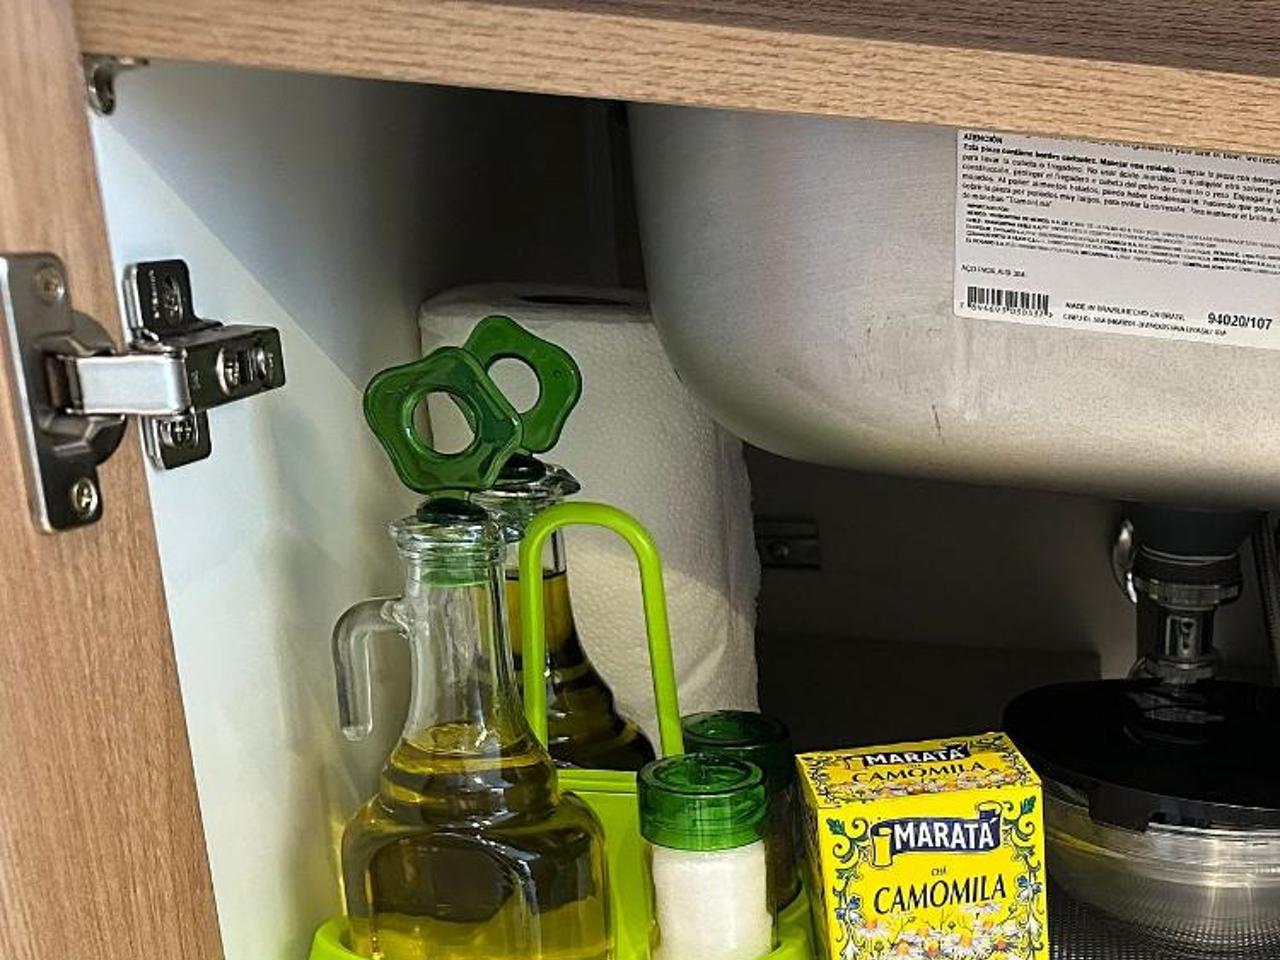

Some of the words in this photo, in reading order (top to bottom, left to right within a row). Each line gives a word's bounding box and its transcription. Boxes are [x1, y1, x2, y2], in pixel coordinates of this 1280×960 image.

[1207, 312, 1273, 329] 94020/107
[852, 761, 987, 783] CAMOMILA
[894, 817, 999, 850] MARATÁ
[874, 874, 1006, 915] CAMOMILA
